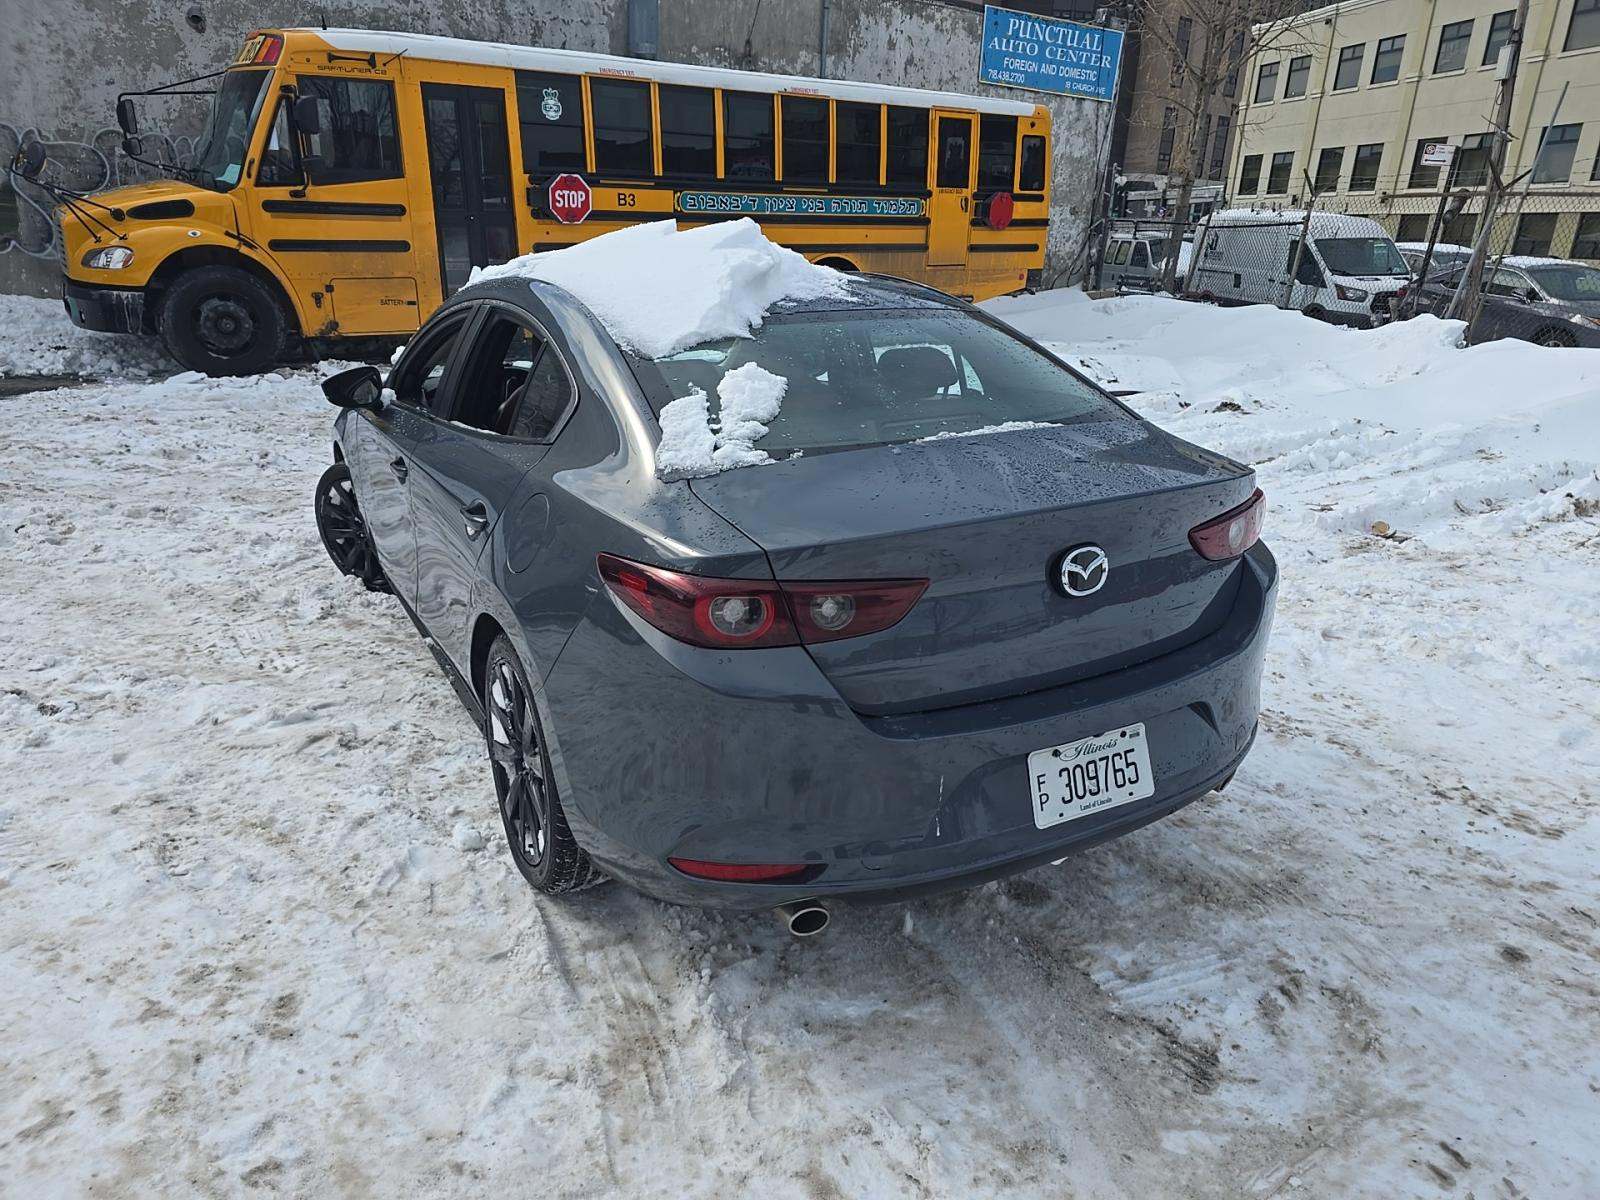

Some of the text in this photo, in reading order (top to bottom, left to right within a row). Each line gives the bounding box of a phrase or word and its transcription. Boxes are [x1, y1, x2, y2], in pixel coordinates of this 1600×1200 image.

[1008, 18, 1101, 51] PUNCTUAL
[989, 37, 1111, 68] AUTO CENTER
[988, 69, 1025, 84] 718.438.2700
[1003, 57, 1098, 81] FOREIGN AND DOMESTIC
[1072, 82, 1095, 92] CHURCH
[555, 189, 586, 208] STOP
[617, 193, 636, 207] B3
[764, 197, 796, 214] ציון
[801, 198, 826, 213] בני
[832, 199, 868, 213] תורה
[873, 198, 917, 214] תלמוד
[1059, 739, 1118, 762] Illinois
[1059, 748, 1139, 804] 309765
